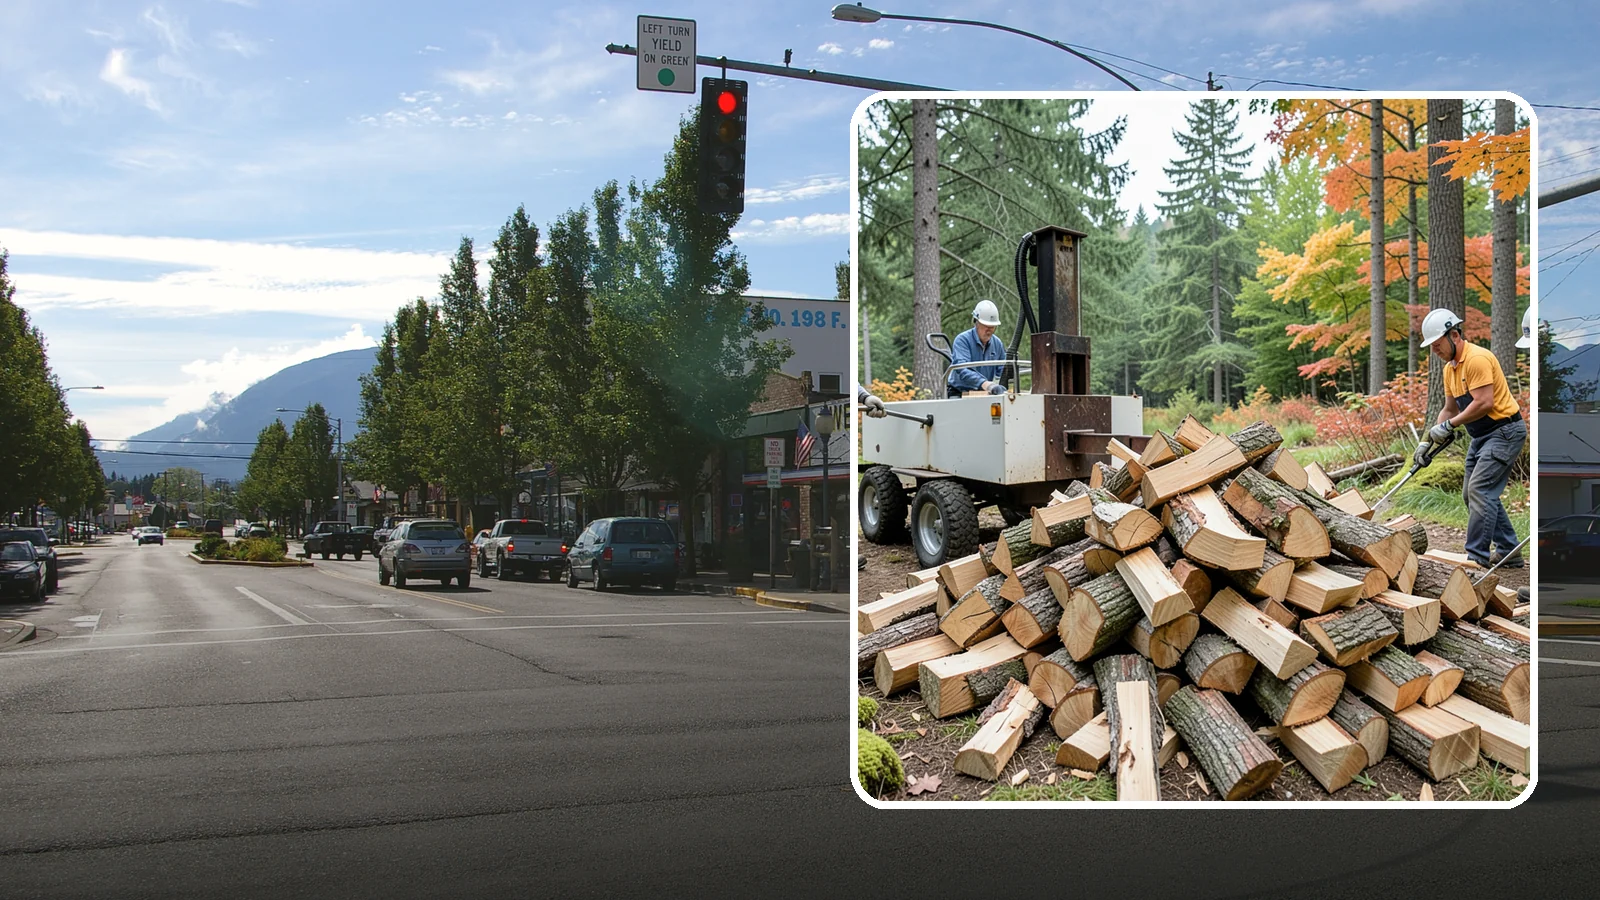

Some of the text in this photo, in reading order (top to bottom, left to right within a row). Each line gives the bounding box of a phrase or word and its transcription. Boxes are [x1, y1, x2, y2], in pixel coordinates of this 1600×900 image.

[642, 23, 690, 37] LEFT TURN
[652, 38, 682, 52] YIELD
[644, 53, 689, 66] ON GREEN
[791, 309, 826, 328] 198
[831, 311, 846, 329] F.
